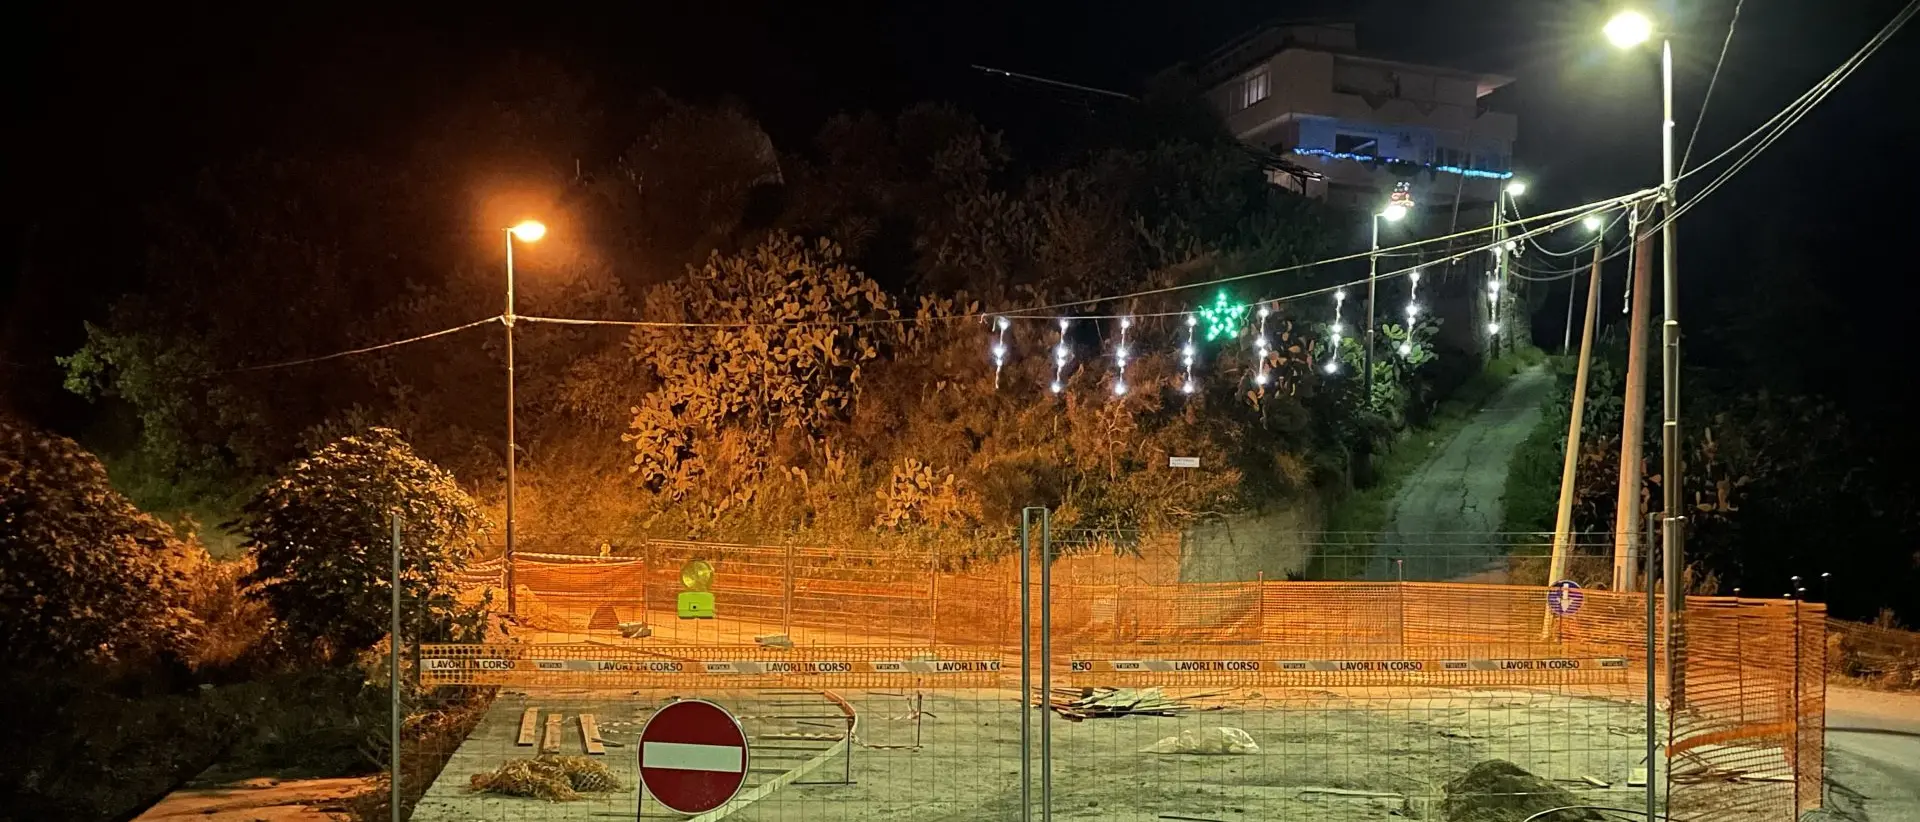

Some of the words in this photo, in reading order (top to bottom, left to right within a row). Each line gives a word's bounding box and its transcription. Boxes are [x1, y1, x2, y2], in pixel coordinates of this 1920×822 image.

[431, 660, 466, 669] LAVORI
[469, 660, 480, 669] IN
[482, 660, 515, 669] CORSO
[598, 662, 633, 671] LAVORI
[636, 662, 647, 671] IN
[650, 662, 683, 671] CORSO
[766, 662, 801, 671] LAVORI
[804, 662, 816, 671] IN
[818, 662, 852, 671] CORSO
[936, 661, 972, 671] LAVORI
[975, 661, 988, 671] IN
[1071, 661, 1092, 670] RSO
[1175, 661, 1210, 670] LAVORI
[1213, 661, 1224, 670] IN
[1226, 661, 1260, 670] CORSO
[1340, 661, 1374, 670] LAVORI
[1377, 661, 1388, 670] IN
[1390, 661, 1423, 670] CORSO
[1500, 660, 1533, 669] LAVORI
[1536, 660, 1547, 669] IN
[1548, 660, 1580, 669] CORSO
